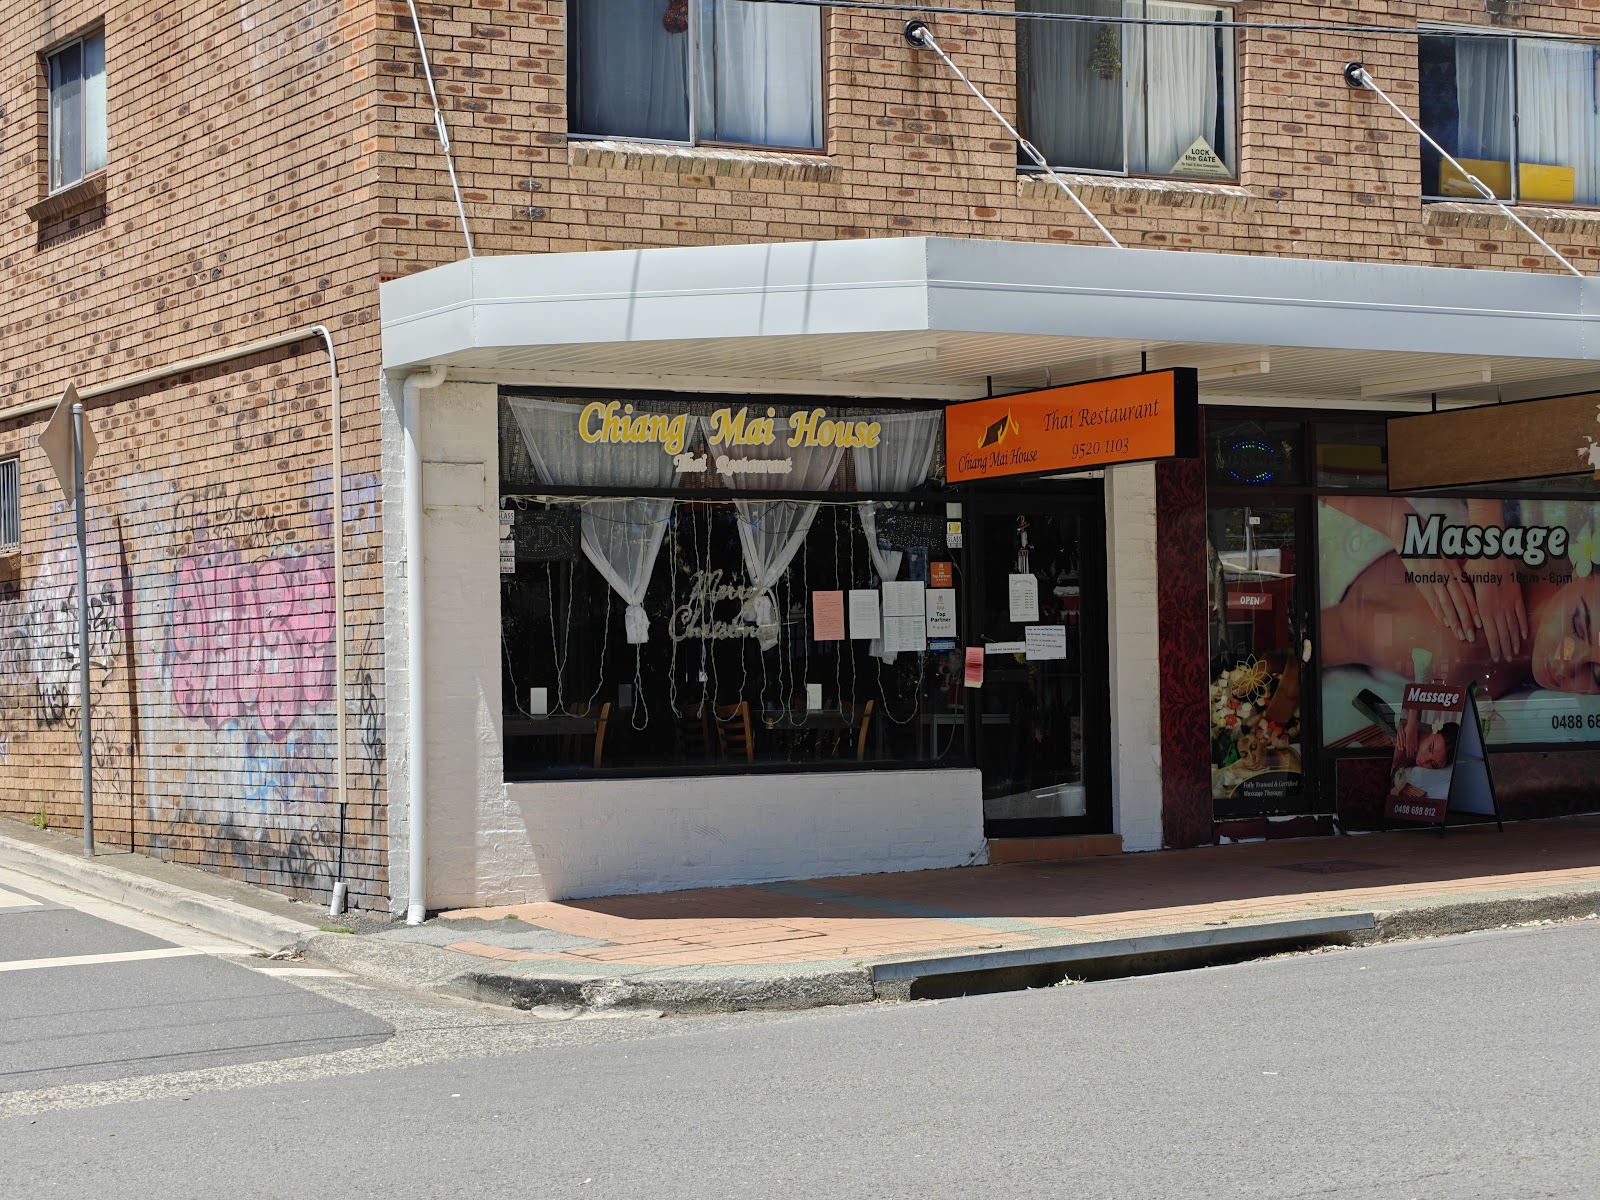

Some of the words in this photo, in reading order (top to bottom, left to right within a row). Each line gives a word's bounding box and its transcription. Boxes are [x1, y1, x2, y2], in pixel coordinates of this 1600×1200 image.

[1191, 148, 1210, 156] LOCK
[1198, 155, 1216, 163] GATE
[1043, 409, 1074, 432] Thai
[1078, 398, 1160, 428] Restaurant
[578, 400, 690, 455] Chiang
[708, 407, 777, 447] Mai
[787, 407, 882, 449] House
[1071, 441, 1101, 460] 9520
[1105, 437, 1130, 454] 1103
[673, 452, 709, 474] Thai
[715, 455, 793, 477] Restaurant
[958, 451, 988, 474] Chiang
[989, 449, 1009, 467] Mai
[1009, 446, 1039, 464] House
[518, 525, 575, 548] PEN
[1400, 513, 1570, 570] Massage
[1404, 571, 1450, 586] Monday
[1460, 571, 1503, 586] Sunday
[1549, 571, 1573, 587] 8pm
[1239, 596, 1261, 606] OPEN
[1407, 687, 1460, 708] Massage
[1551, 714, 1583, 729] 0488
[1243, 781, 1255, 790] Fully
[1255, 780, 1273, 788] Trained
[1243, 790, 1264, 798] Massage
[1394, 804, 1410, 815] 0488
[1411, 805, 1423, 816] 688
[1424, 806, 1436, 818] 612
